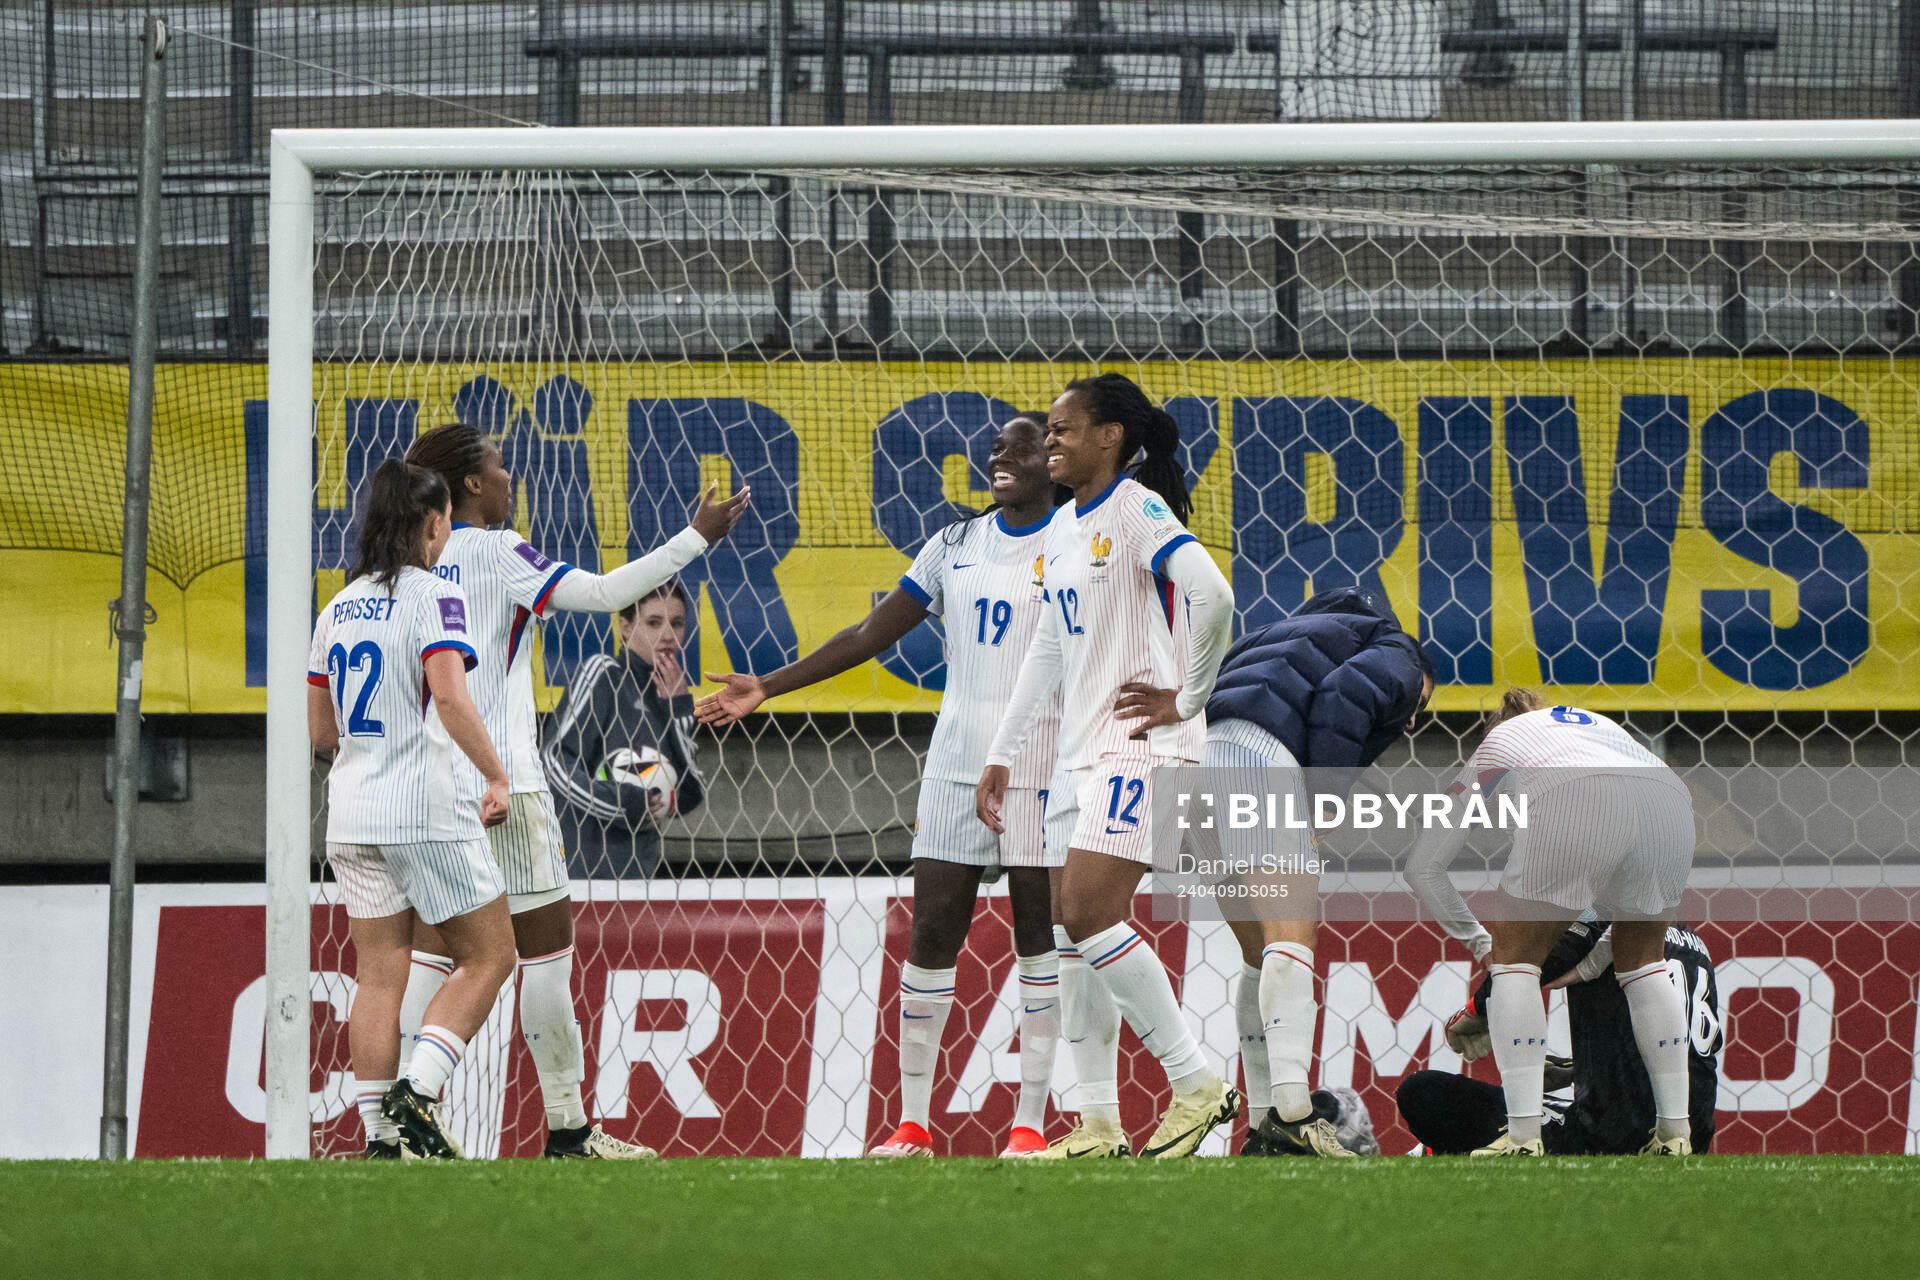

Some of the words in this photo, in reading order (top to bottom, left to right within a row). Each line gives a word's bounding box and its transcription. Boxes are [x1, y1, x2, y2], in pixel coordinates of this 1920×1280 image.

[332, 597, 397, 625] PERISSET
[974, 597, 1014, 647] 19
[1057, 587, 1085, 636] 12
[327, 640, 385, 737] 22
[1107, 775, 1144, 827] 12
